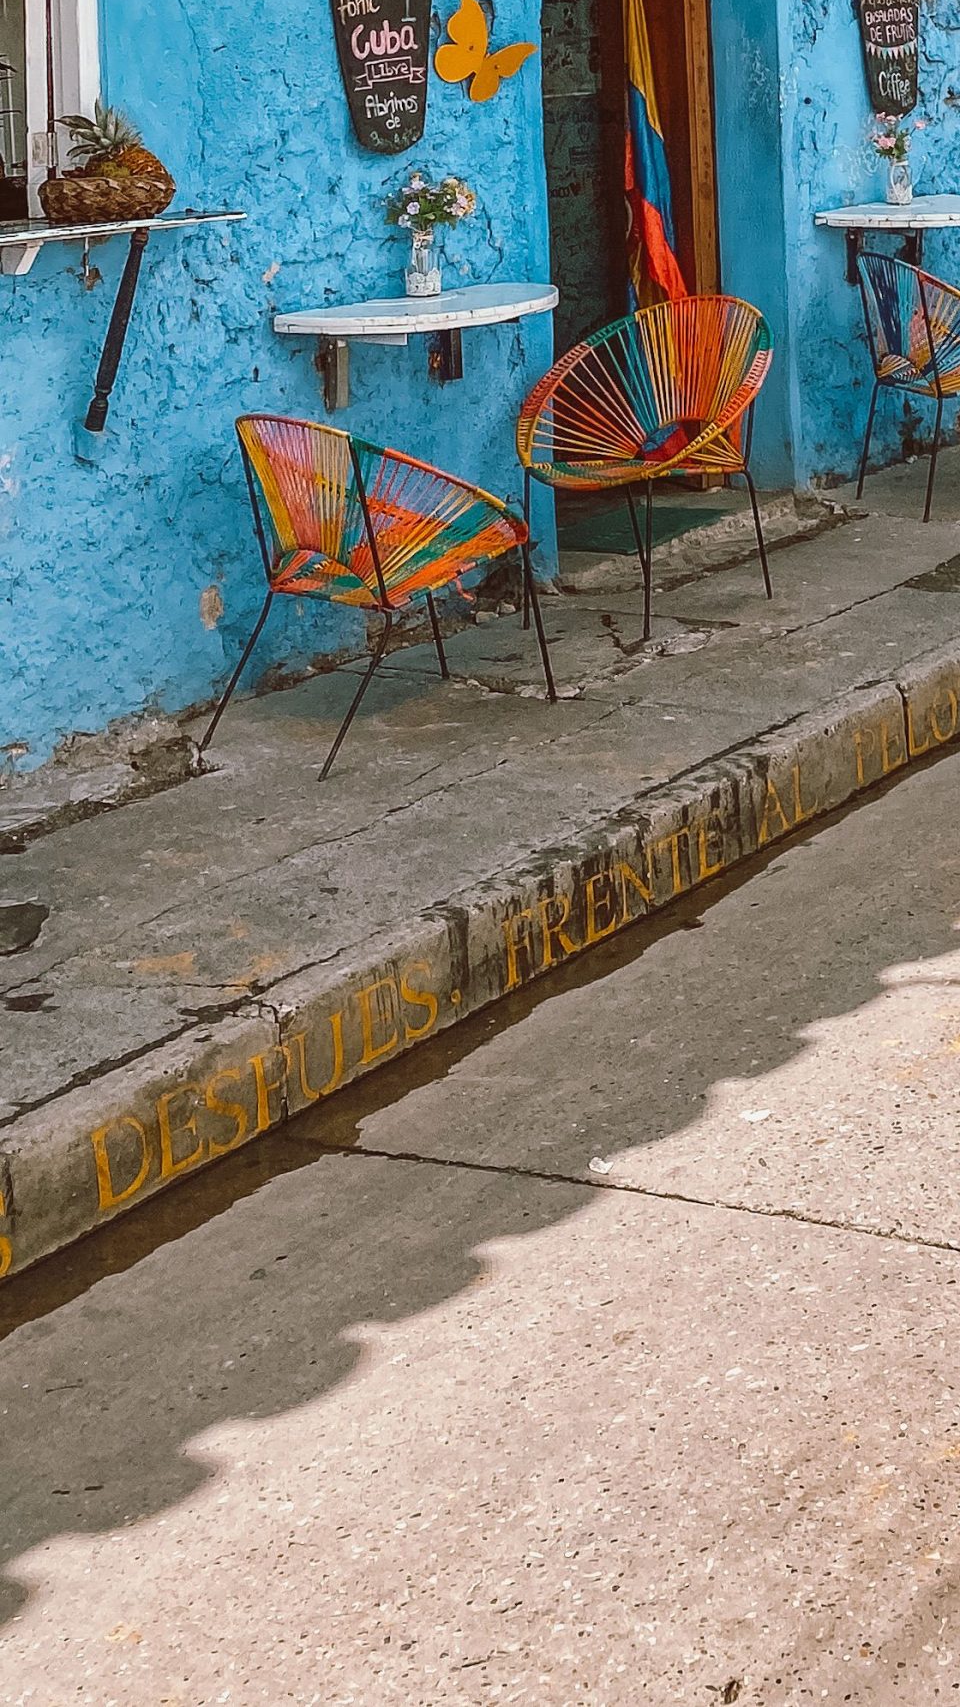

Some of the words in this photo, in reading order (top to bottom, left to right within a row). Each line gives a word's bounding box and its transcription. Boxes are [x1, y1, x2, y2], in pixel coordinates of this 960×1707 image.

[865, 7, 914, 25] ENSALADAS
[351, 19, 419, 60] Cuba
[870, 26, 882, 42] DE
[386, 112, 401, 129] de
[501, 809, 726, 994] FRENTE
[758, 766, 818, 845] AL
